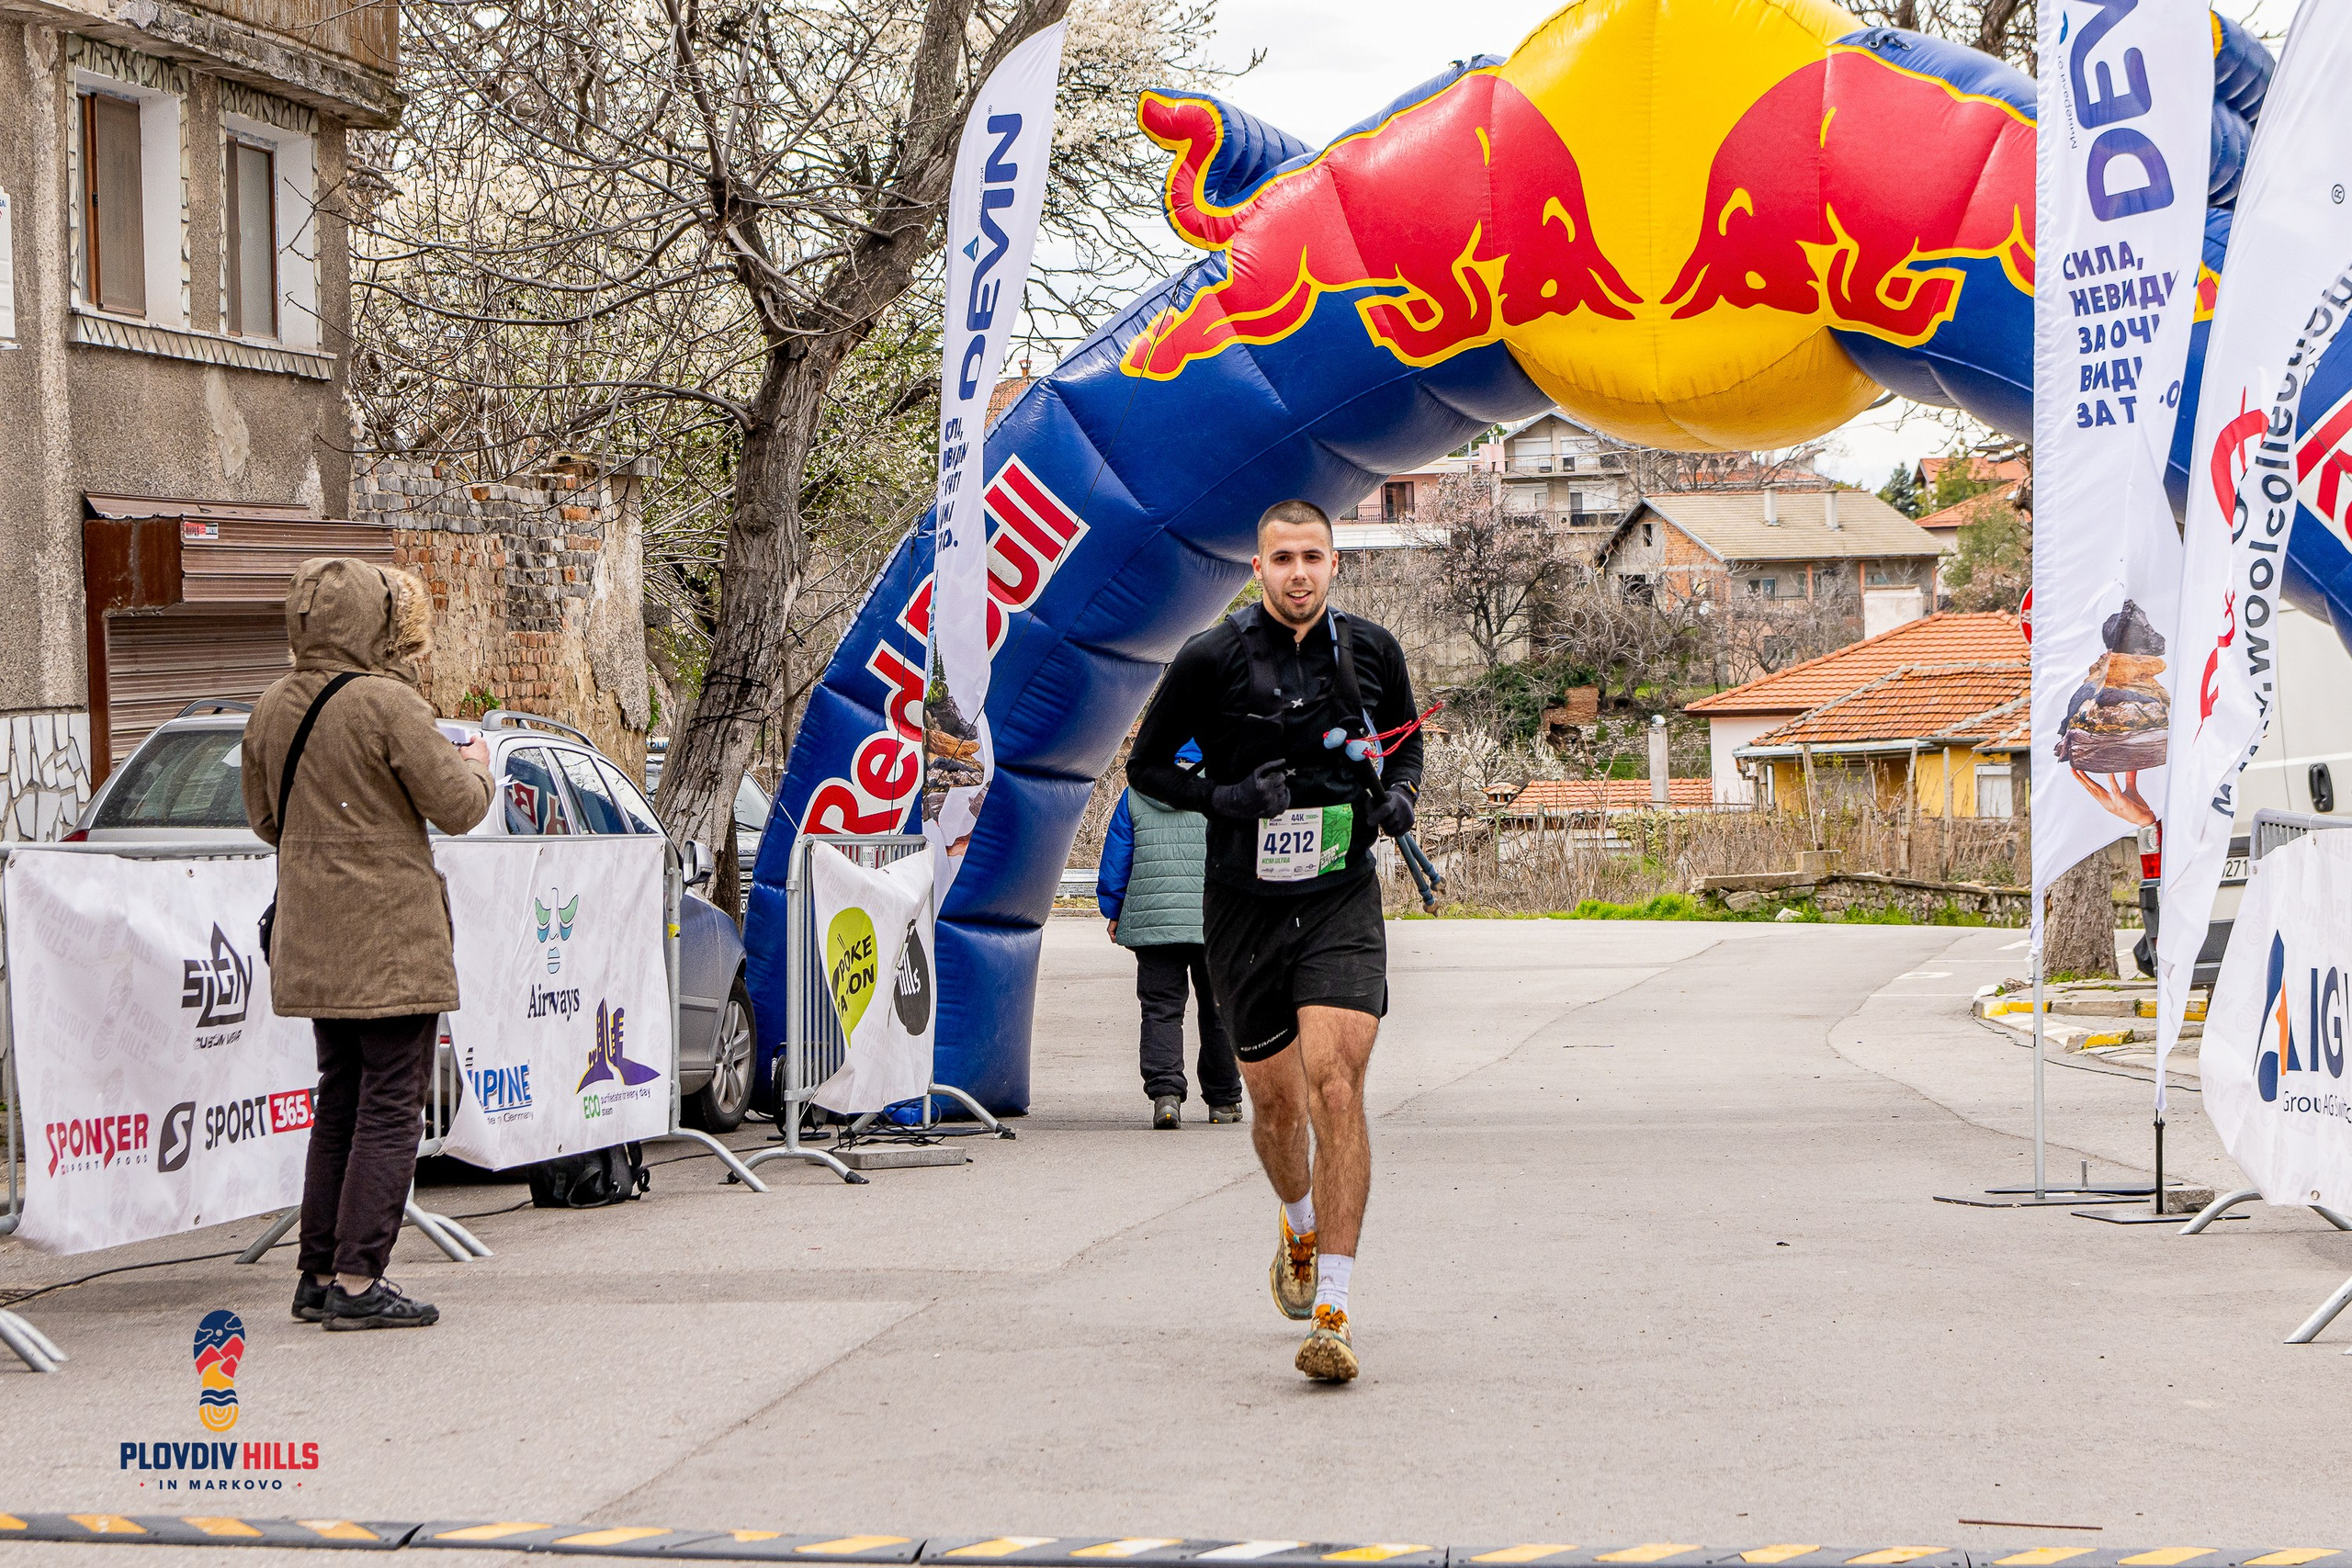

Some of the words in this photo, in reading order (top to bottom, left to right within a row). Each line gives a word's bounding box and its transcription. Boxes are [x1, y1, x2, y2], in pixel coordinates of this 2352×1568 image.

[958, 113, 1023, 401] DEVIN
[2063, 241, 2143, 281] СИЛА,
[1291, 814, 1305, 822] 44K
[1263, 830, 1314, 854] 4212
[2222, 859, 2248, 878] 271
[839, 934, 873, 982] POKE
[527, 984, 580, 1021] Airways
[2311, 966, 2352, 1079] IG
[206, 1095, 266, 1150] SPORT
[583, 1094, 601, 1119] ECO
[46, 1113, 149, 1179] SPONSER
